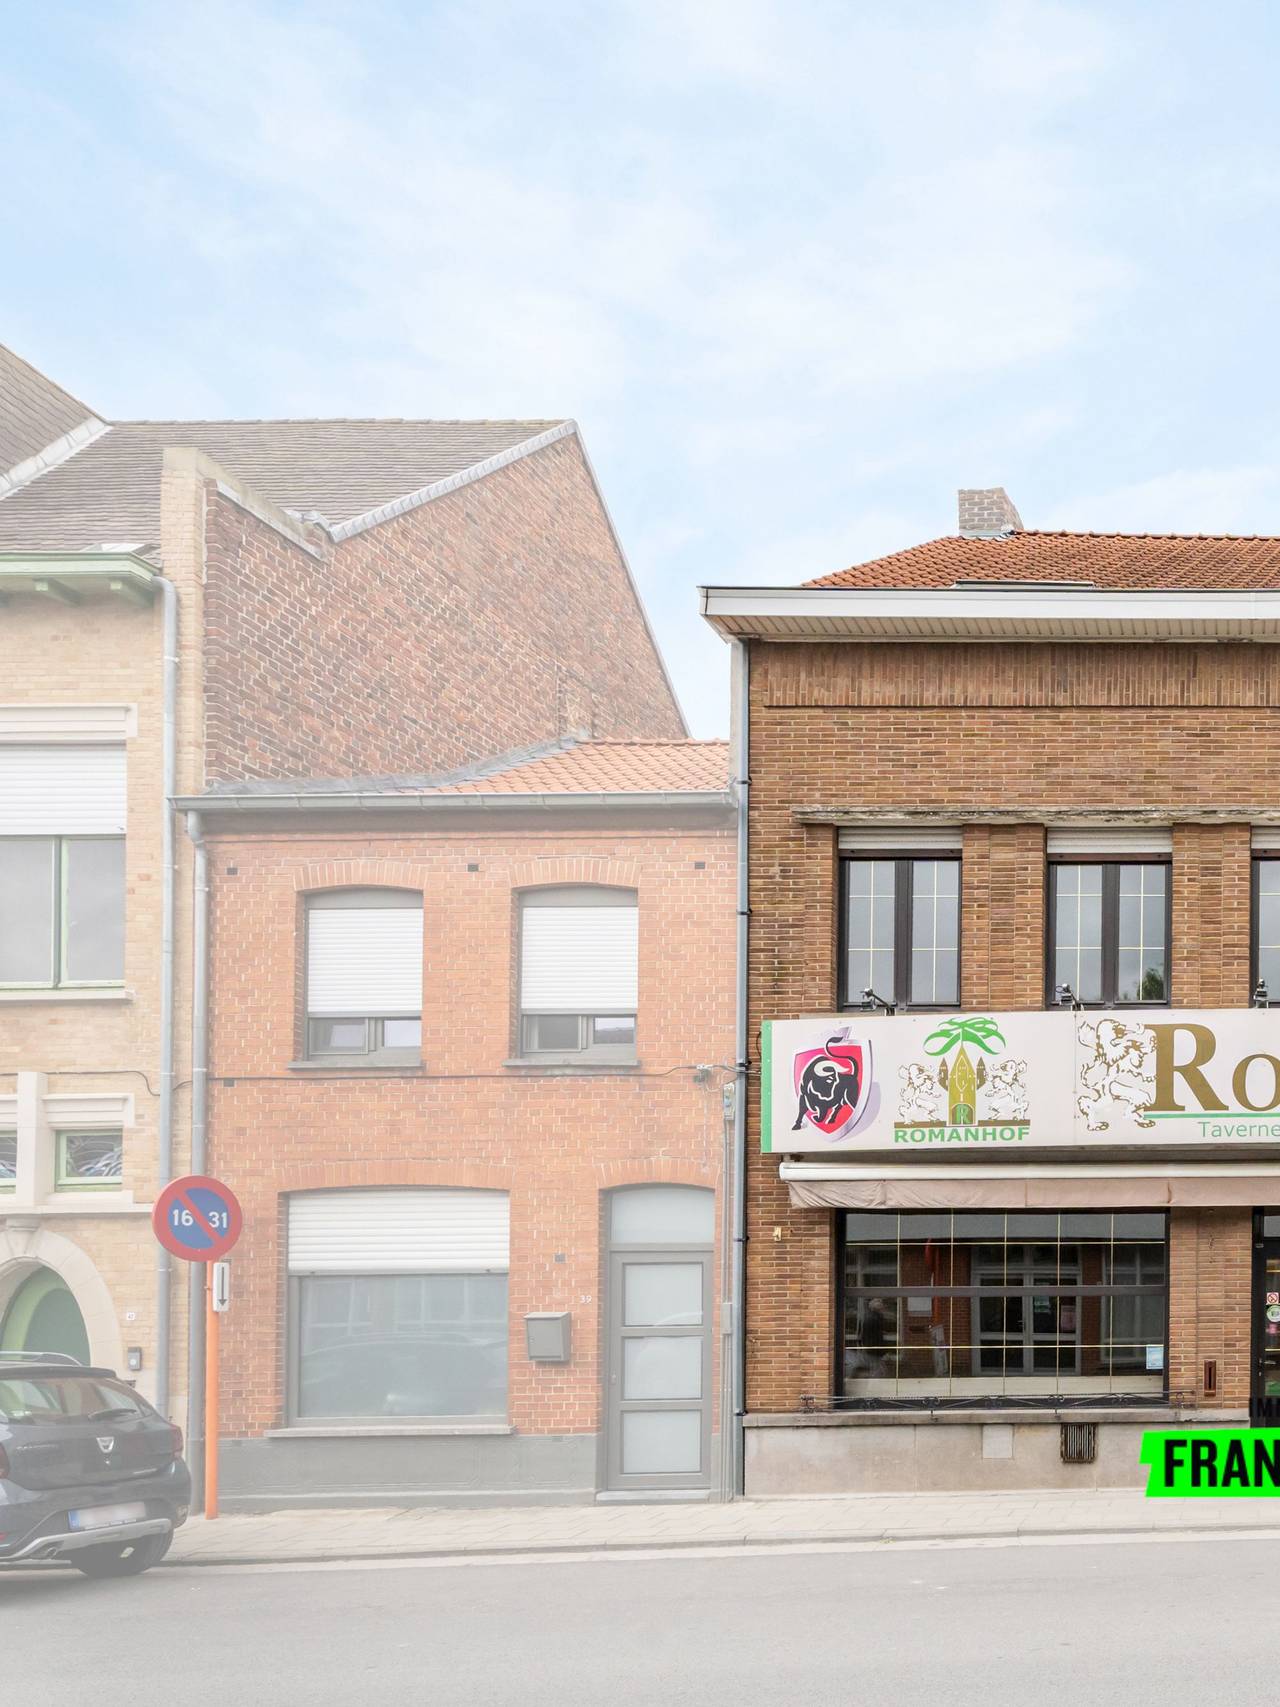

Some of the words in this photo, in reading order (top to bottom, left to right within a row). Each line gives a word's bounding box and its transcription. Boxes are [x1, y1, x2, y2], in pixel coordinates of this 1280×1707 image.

[894, 1126, 1030, 1143] ROMANHOF
[172, 1208, 194, 1227] 16
[208, 1211, 228, 1229] 31
